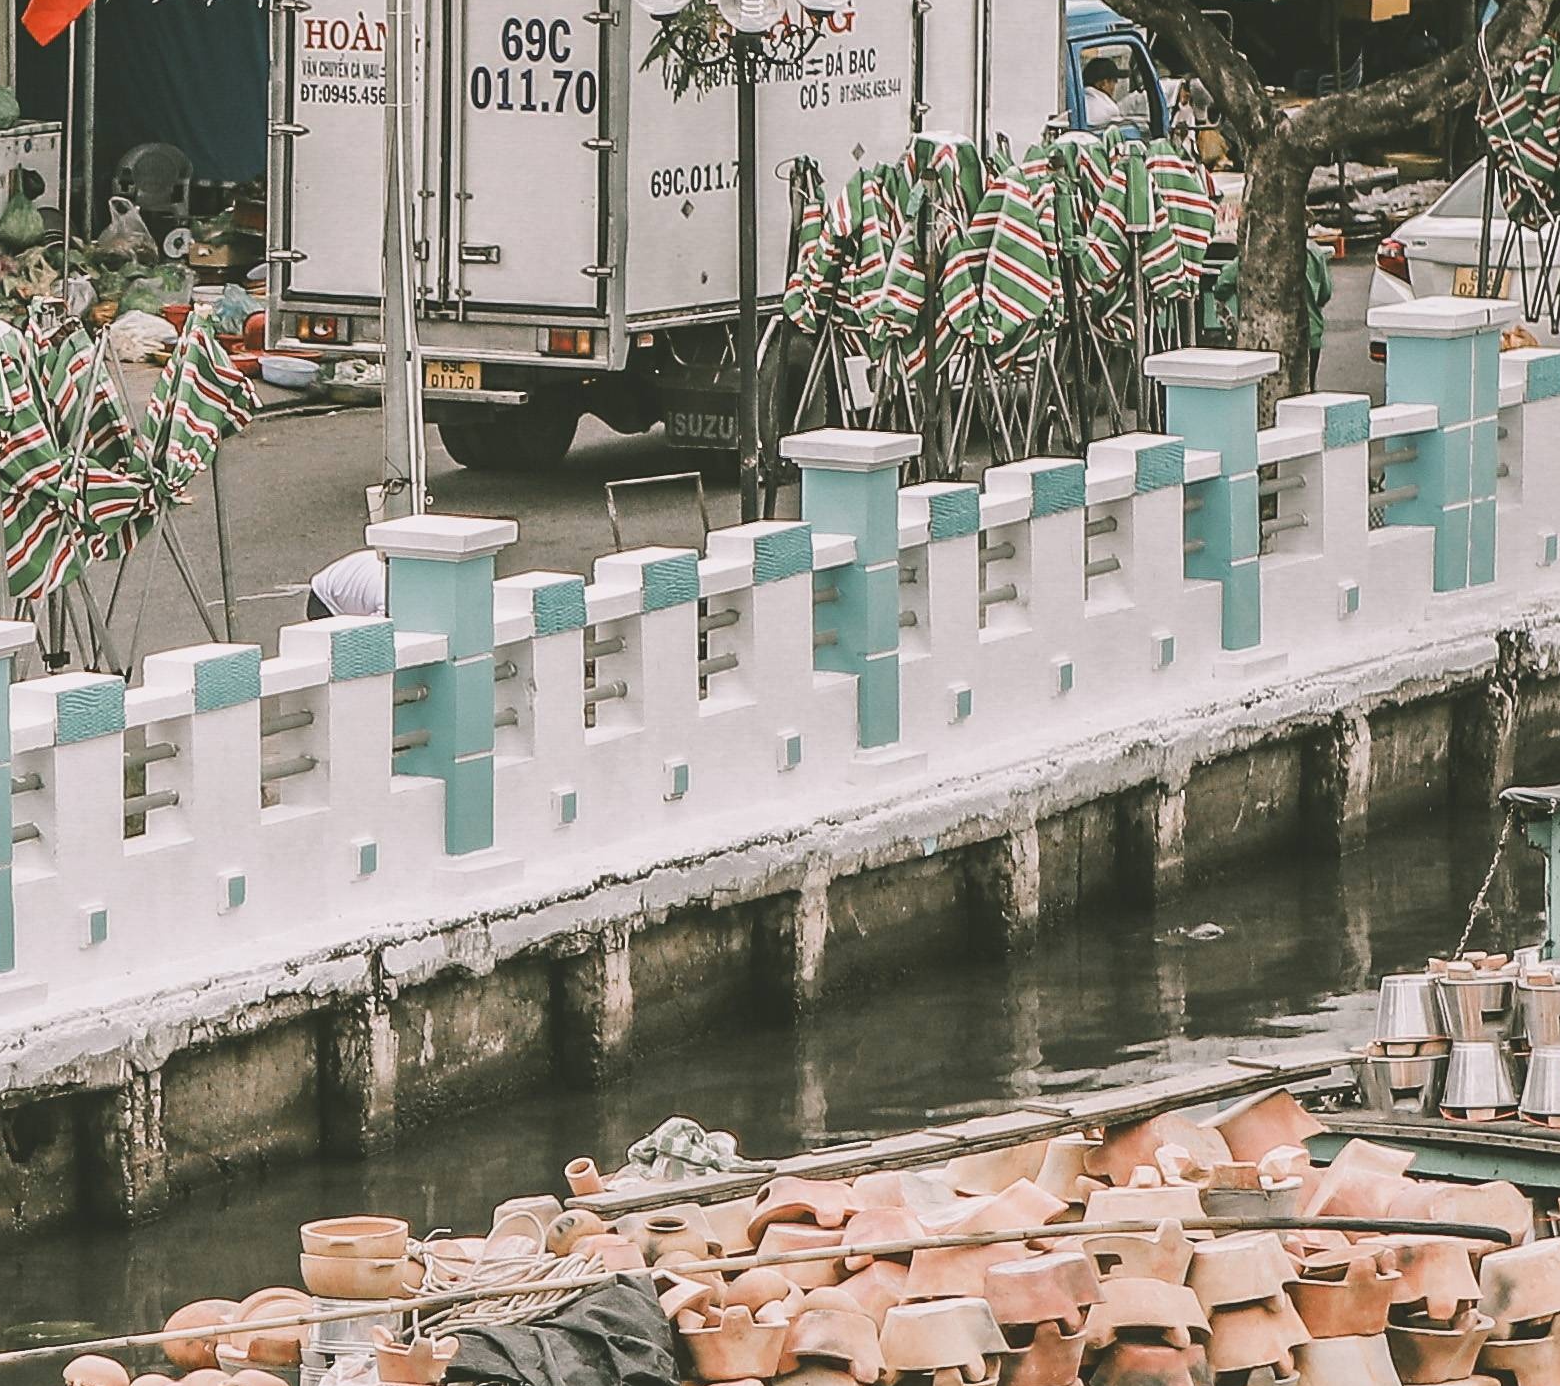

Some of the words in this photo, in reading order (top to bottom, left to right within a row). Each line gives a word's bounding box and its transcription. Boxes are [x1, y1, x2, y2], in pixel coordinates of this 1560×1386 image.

[502, 17, 573, 63] 69C
[824, 44, 845, 78] ĐÁ
[848, 47, 877, 79] BẠC
[300, 83, 387, 106] ĐT:0945.456
[470, 66, 598, 115] 011.70
[820, 82, 831, 107] 5
[650, 160, 740, 198] 69C.011.7
[430, 373, 475, 391] 011.70
